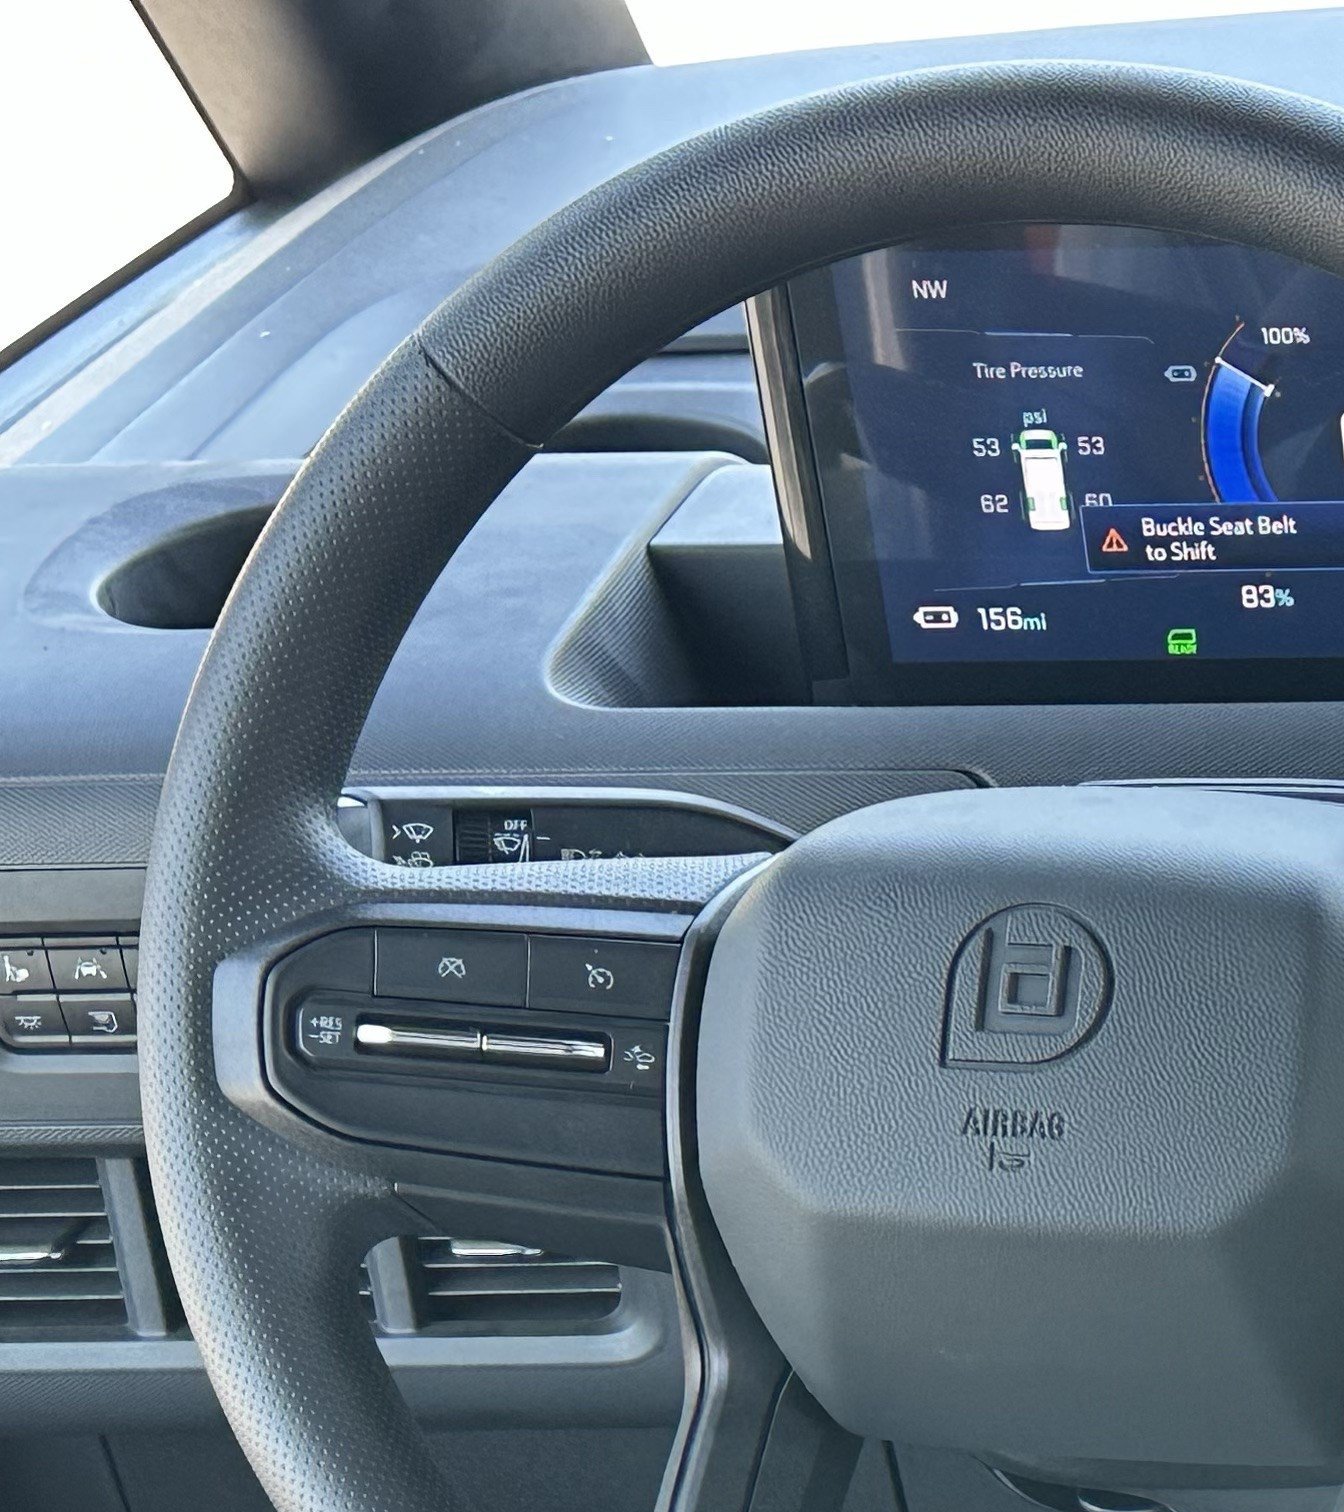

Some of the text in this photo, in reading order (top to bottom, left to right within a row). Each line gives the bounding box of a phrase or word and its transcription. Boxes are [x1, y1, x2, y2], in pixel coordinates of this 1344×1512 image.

[911, 279, 948, 299] NW
[1260, 326, 1311, 345] 100%
[972, 361, 1084, 379] Tire Pressure
[1022, 408, 1048, 428] psi
[972, 437, 1001, 457] 53
[1077, 436, 1105, 456] 53
[980, 494, 1009, 513] 62
[1141, 514, 1298, 537] Buckle Seat Belt
[1145, 540, 1217, 562] to Shift
[1241, 584, 1295, 609] 83%
[976, 606, 1047, 631] 156mi
[503, 819, 527, 831] OFF
[962, 1106, 1067, 1139] AIRBAG
